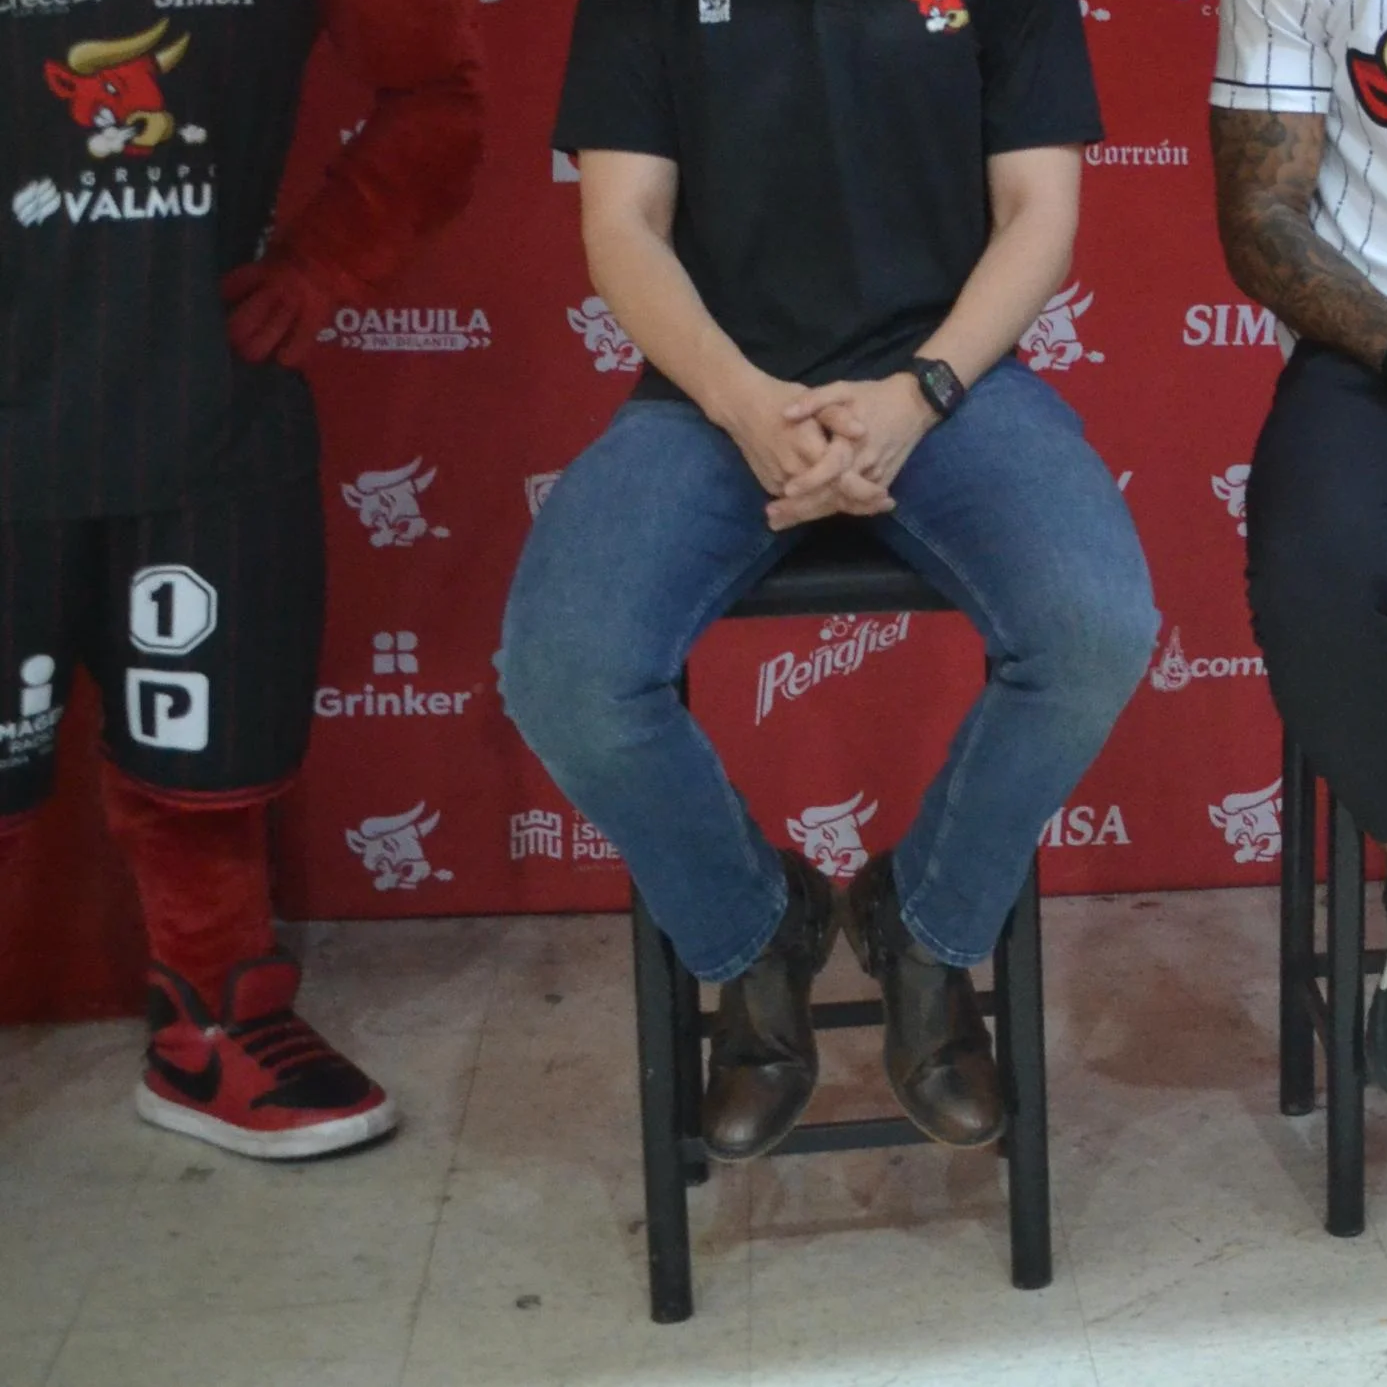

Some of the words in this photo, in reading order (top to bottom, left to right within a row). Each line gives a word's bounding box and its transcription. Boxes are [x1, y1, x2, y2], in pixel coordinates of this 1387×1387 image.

[1084, 139, 1189, 166] Torreón
[64, 182, 213, 224] VALMU
[149, 581, 174, 638] 1
[313, 685, 471, 717] Grinker
